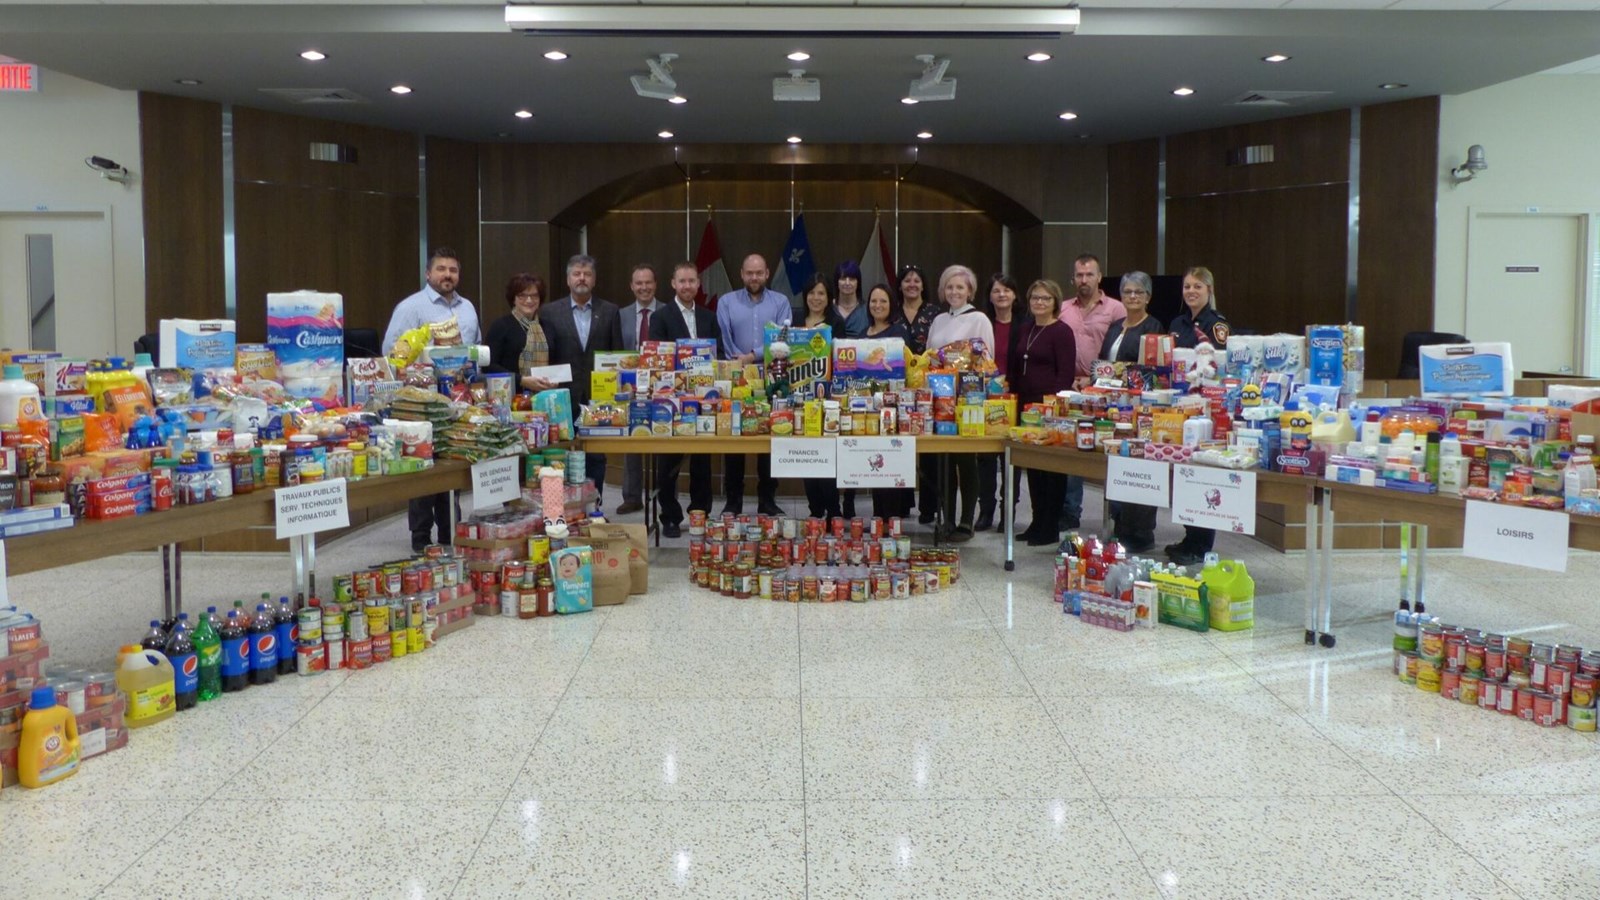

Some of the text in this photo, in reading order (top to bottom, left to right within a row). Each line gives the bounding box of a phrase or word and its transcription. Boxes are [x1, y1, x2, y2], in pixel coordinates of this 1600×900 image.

[296, 331, 342, 348] Cashmere
[838, 350, 855, 361] 40
[1231, 350, 1250, 363] Silky
[1266, 346, 1286, 360] Silky
[789, 356, 827, 383] unty
[1278, 456, 1307, 467] Scotties
[1122, 470, 1152, 480] FINANCES
[97, 479, 127, 488] Colgate
[104, 491, 134, 502] Colgate
[281, 486, 342, 501] TRAVAUX PUBLICS
[105, 503, 136, 515] Colgate
[280, 497, 343, 514] SERV. TECHNIQUES
[287, 509, 338, 523] INFORMATIQUE
[1496, 528, 1534, 540] LOISIRS
